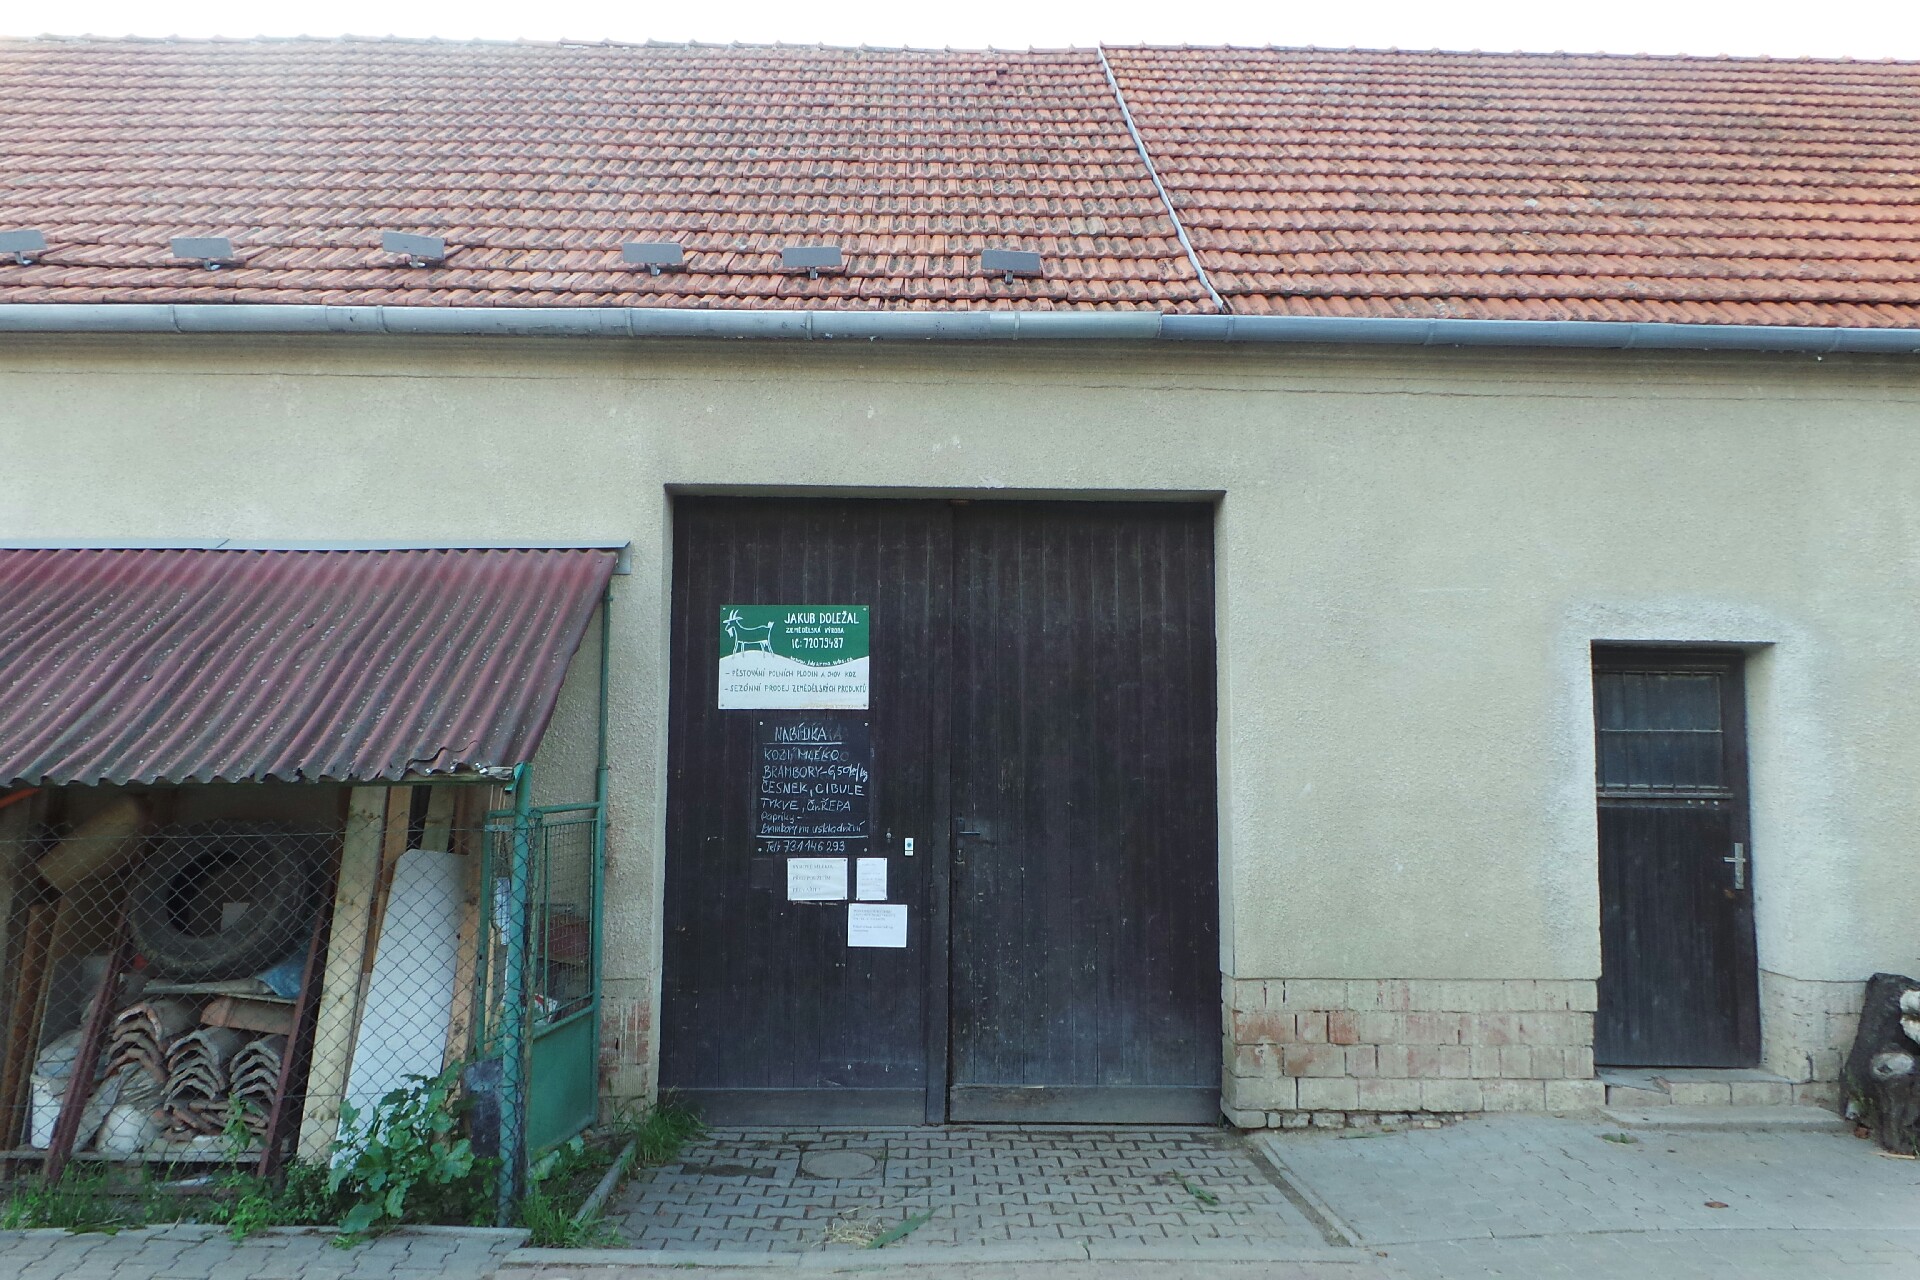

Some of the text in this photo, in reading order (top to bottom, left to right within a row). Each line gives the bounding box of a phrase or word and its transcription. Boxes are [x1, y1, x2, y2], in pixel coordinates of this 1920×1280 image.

[784, 610, 860, 624] JAKUB DOLEŽAL
[768, 668, 794, 678] POLNÍCH
[764, 684, 790, 692] PRODEJ
[774, 722, 827, 742] NABÍDKA
[815, 782, 865, 797] CIBULE
